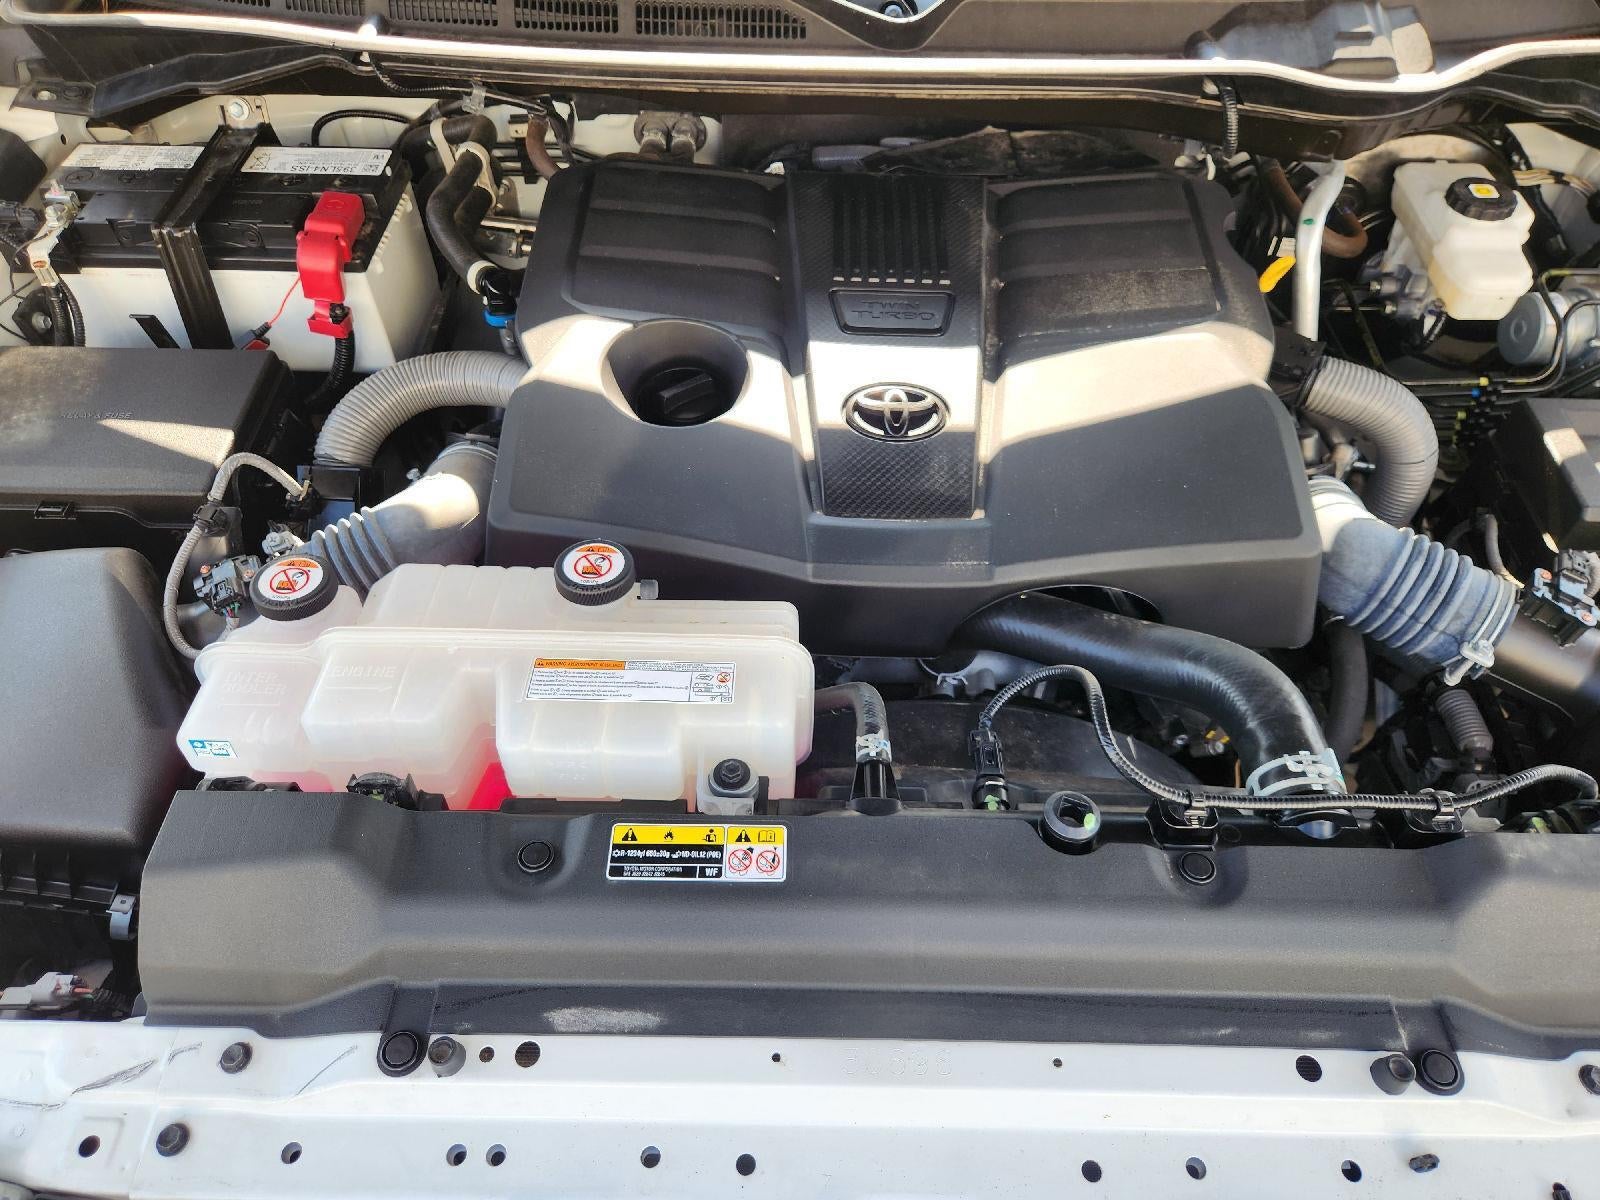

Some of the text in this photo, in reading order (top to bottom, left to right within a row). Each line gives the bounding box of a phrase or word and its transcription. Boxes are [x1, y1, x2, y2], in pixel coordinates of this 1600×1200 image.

[861, 301, 920, 310] TWIN
[851, 310, 936, 320] TURBO
[333, 665, 398, 679] ENGINE
[705, 868, 719, 877] WF
